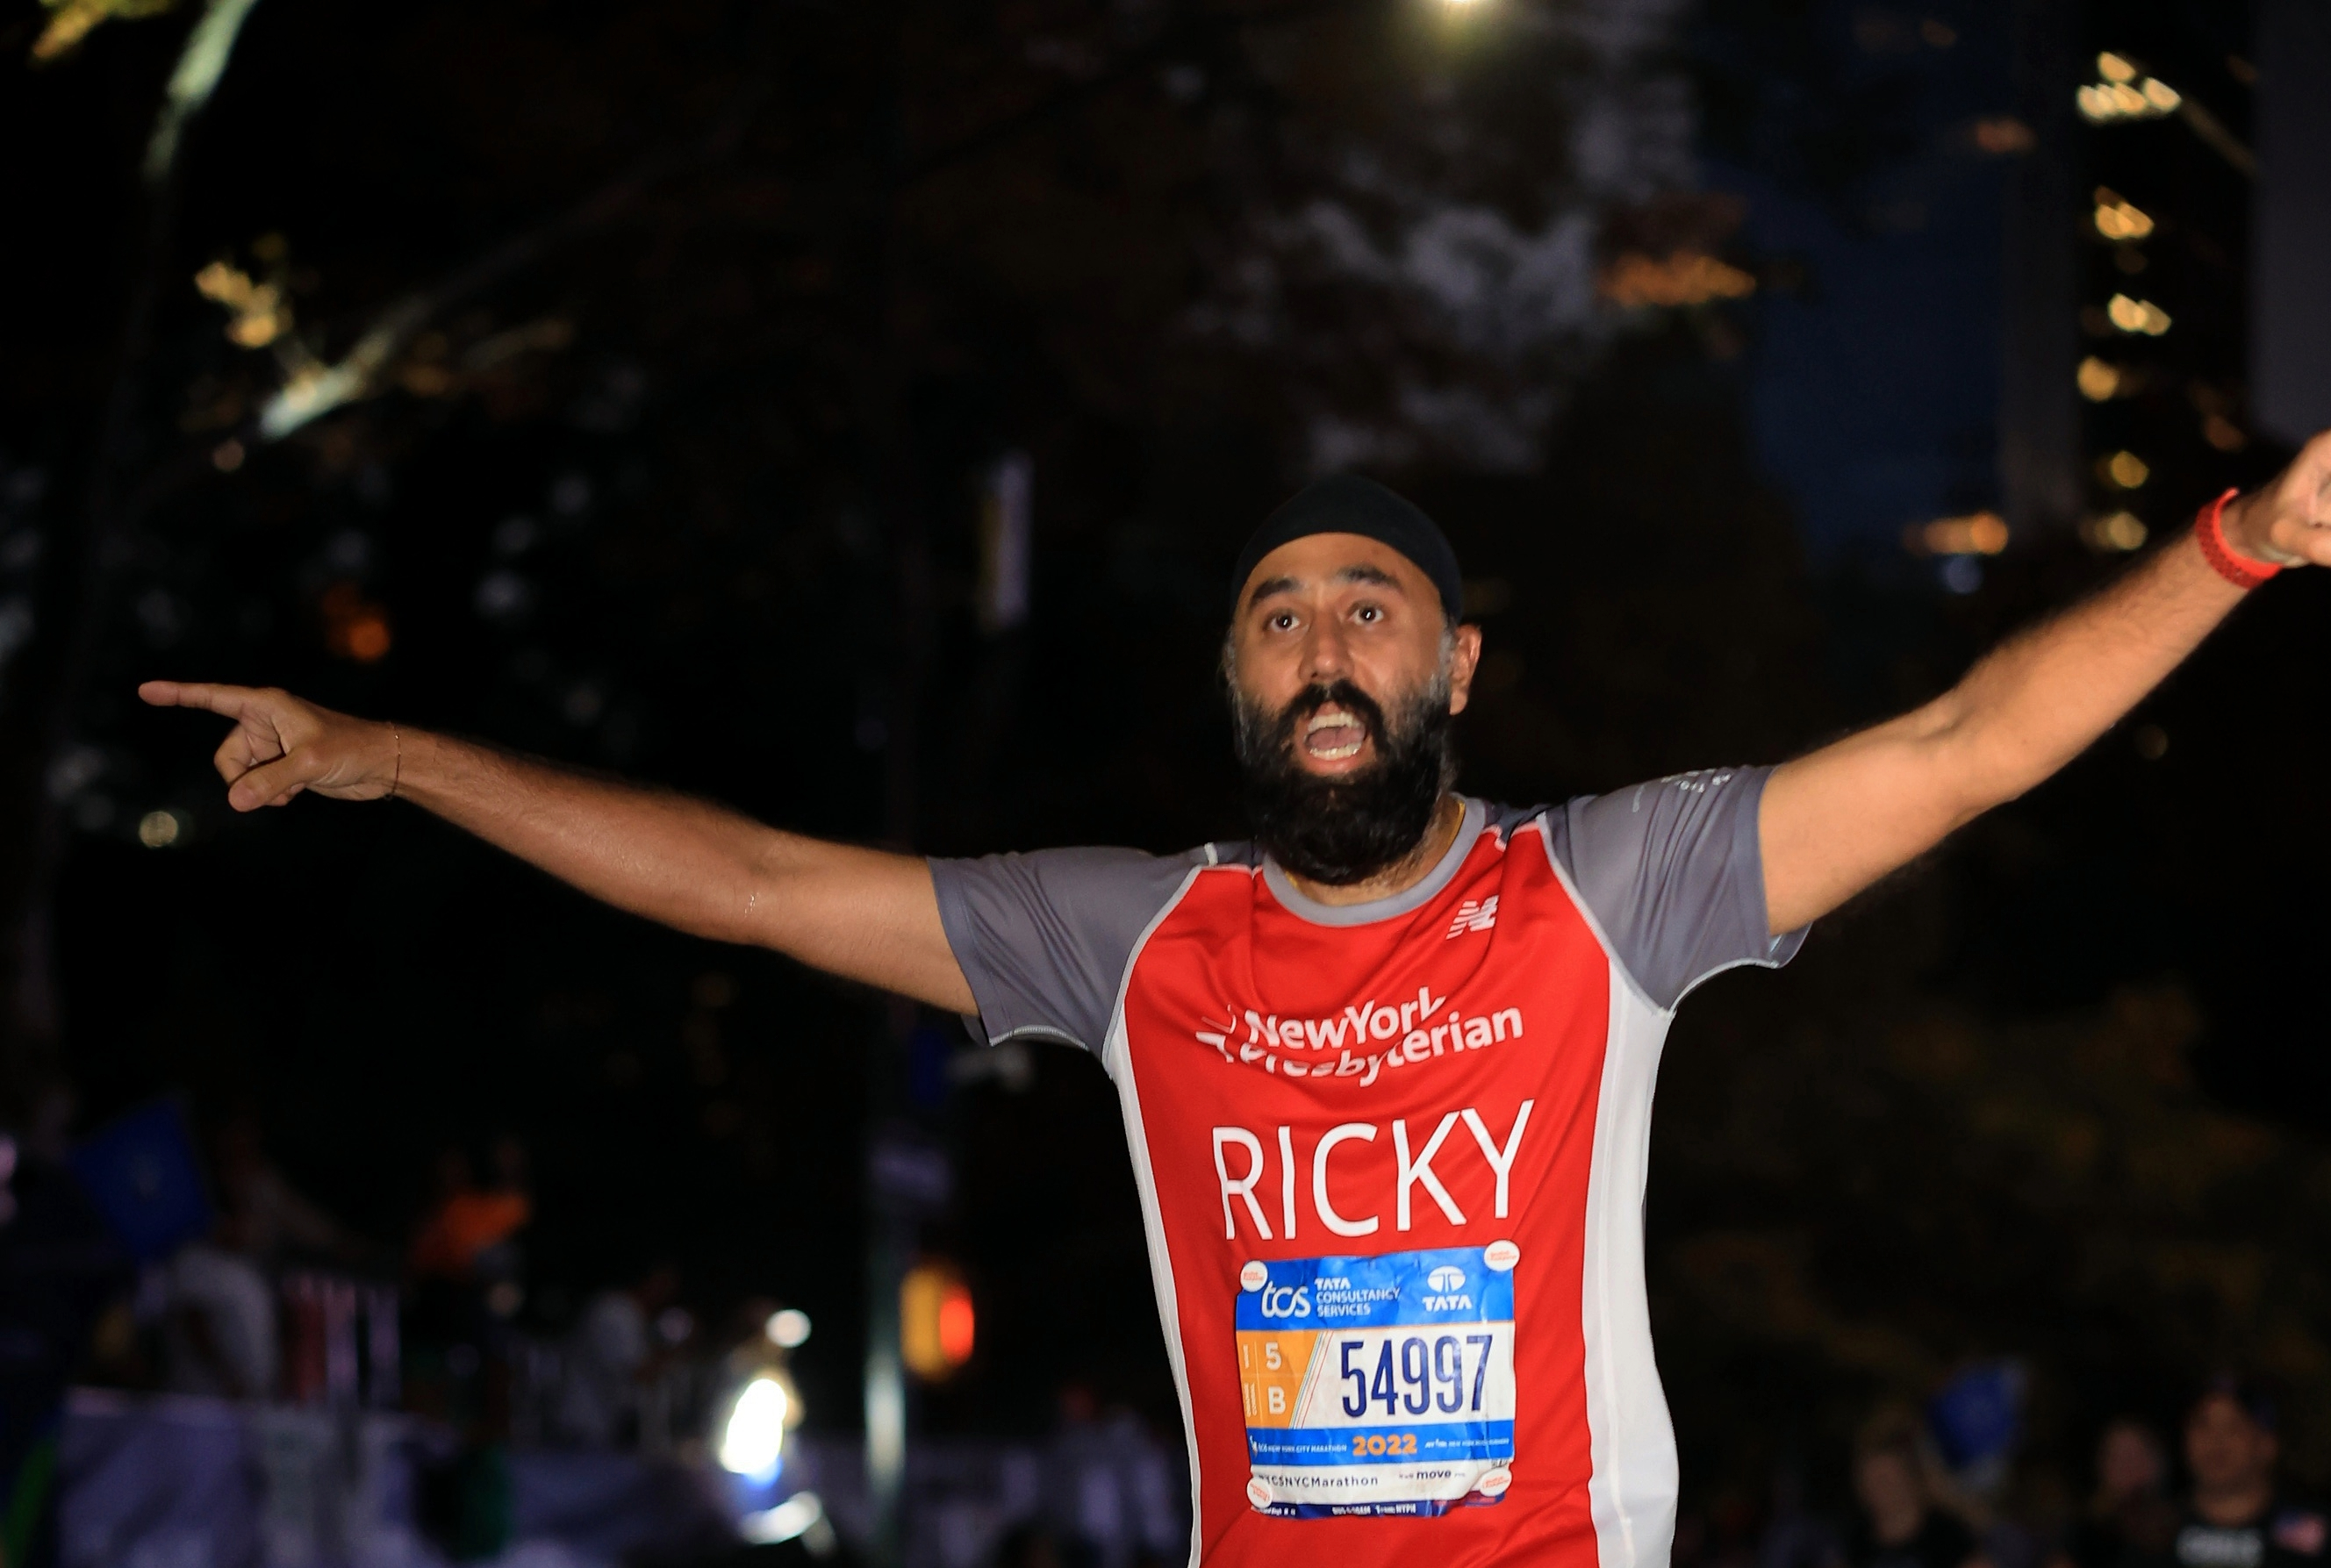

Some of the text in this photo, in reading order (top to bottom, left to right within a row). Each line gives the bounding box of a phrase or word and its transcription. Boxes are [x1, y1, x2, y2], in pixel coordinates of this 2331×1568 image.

[1212, 1099, 1535, 1241] RICKY
[1314, 1277, 1351, 1291] TATA
[1315, 1286, 1401, 1304] CONSULTANCY
[1260, 1278, 1311, 1319] tcs
[1316, 1302, 1371, 1317] SERVICES
[1422, 1295, 1473, 1312] TATA
[1266, 1342, 1281, 1371] 5
[1340, 1334, 1494, 1418] 54997
[1267, 1385, 1287, 1414] B
[1352, 1434, 1418, 1457] 2022
[1416, 1470, 1452, 1481] move
